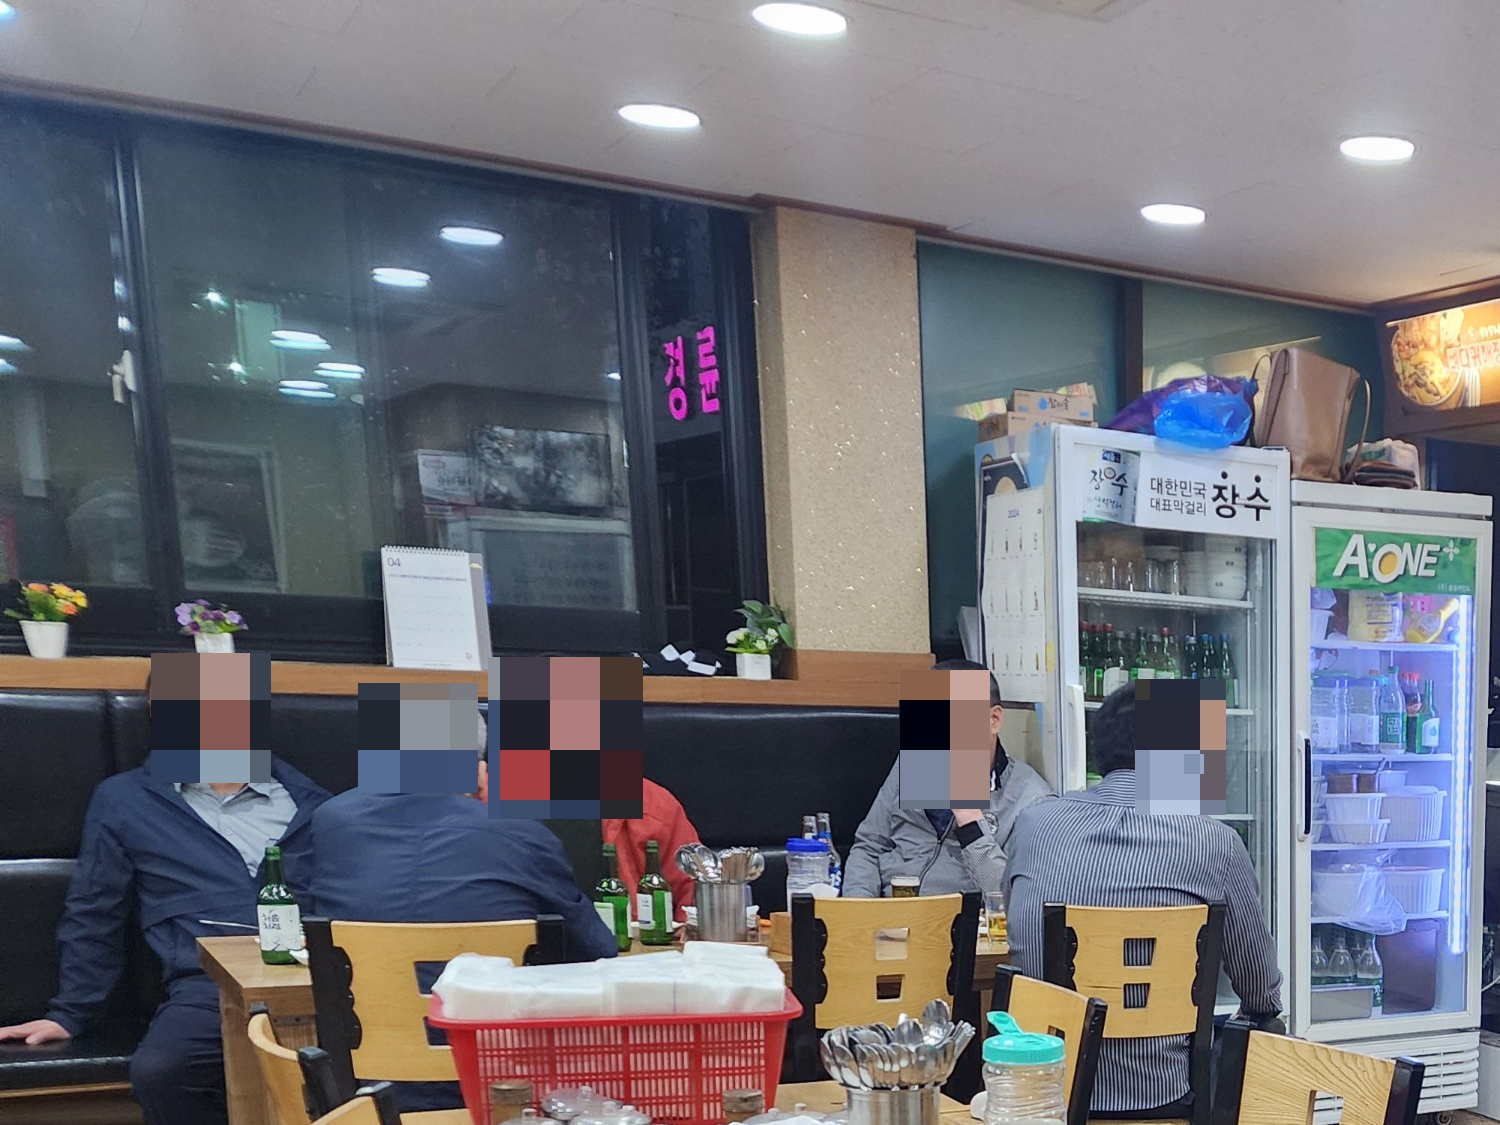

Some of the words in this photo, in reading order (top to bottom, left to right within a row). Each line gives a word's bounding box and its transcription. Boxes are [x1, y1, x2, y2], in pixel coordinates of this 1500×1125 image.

[1150, 477, 1207, 499] 대한민국
[1212, 471, 1271, 521] 장수
[1150, 498, 1207, 516] 대표막걸리
[387, 557, 401, 567] 04
